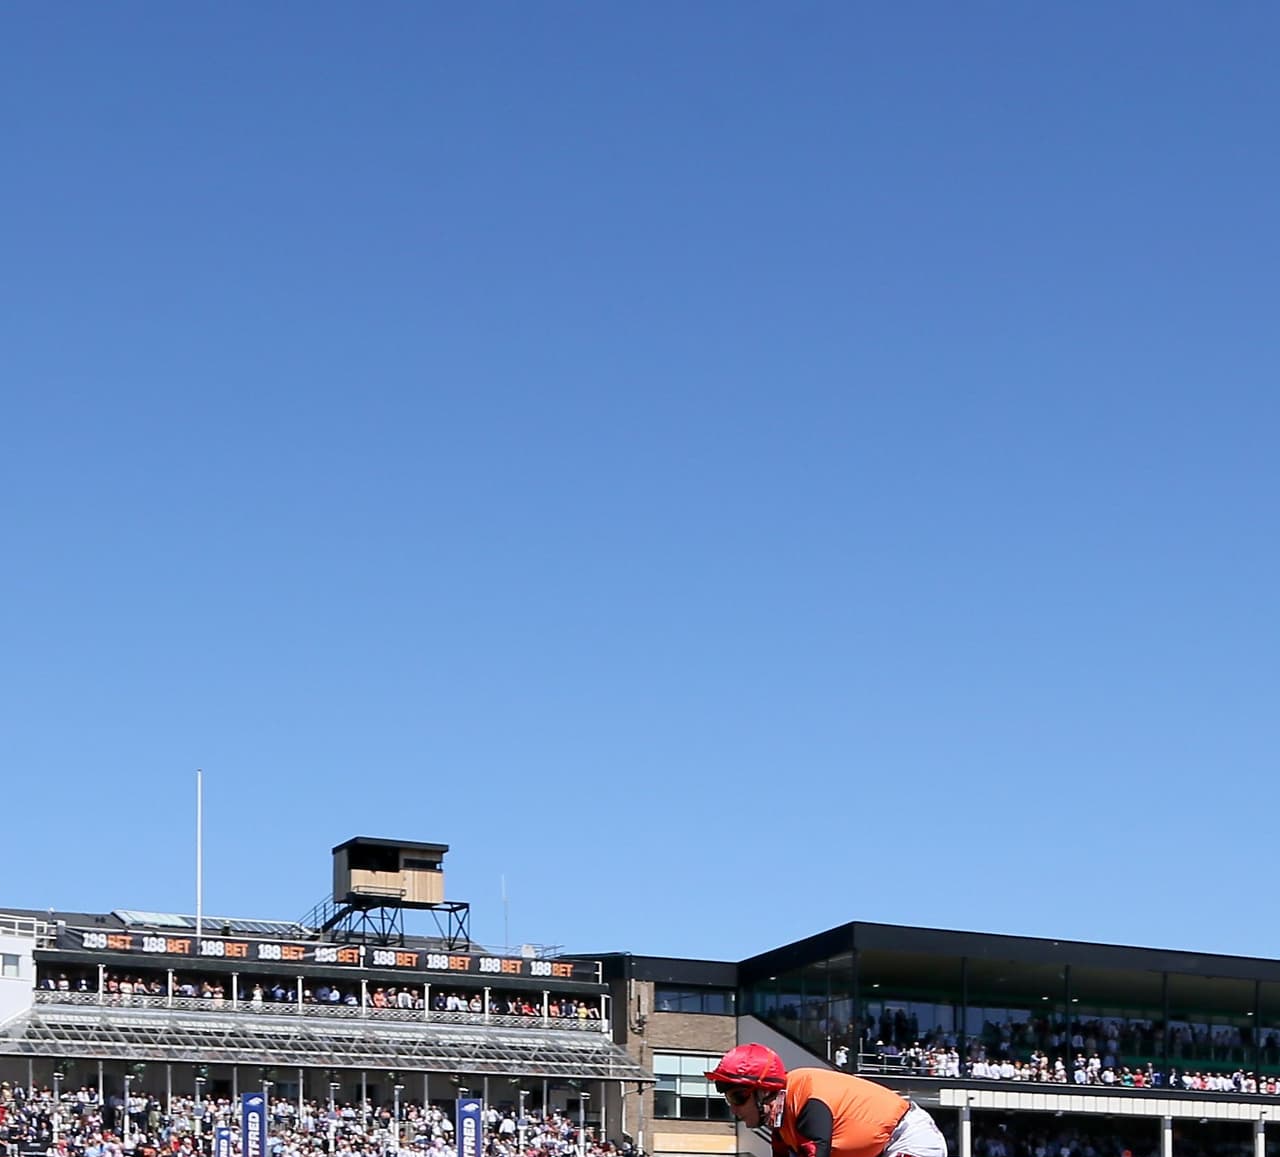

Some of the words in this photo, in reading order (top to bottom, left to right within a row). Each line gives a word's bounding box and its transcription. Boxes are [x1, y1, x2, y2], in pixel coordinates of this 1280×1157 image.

[82, 931, 133, 950] 188BET
[142, 936, 191, 955] 188BET
[200, 940, 248, 958] 188BET
[257, 943, 306, 961] 188BET
[314, 945, 359, 964] 188BET
[373, 950, 418, 967] 188BET
[426, 954, 471, 971] 188BET
[479, 957, 522, 974] 188BET
[530, 960, 574, 977] 188BET
